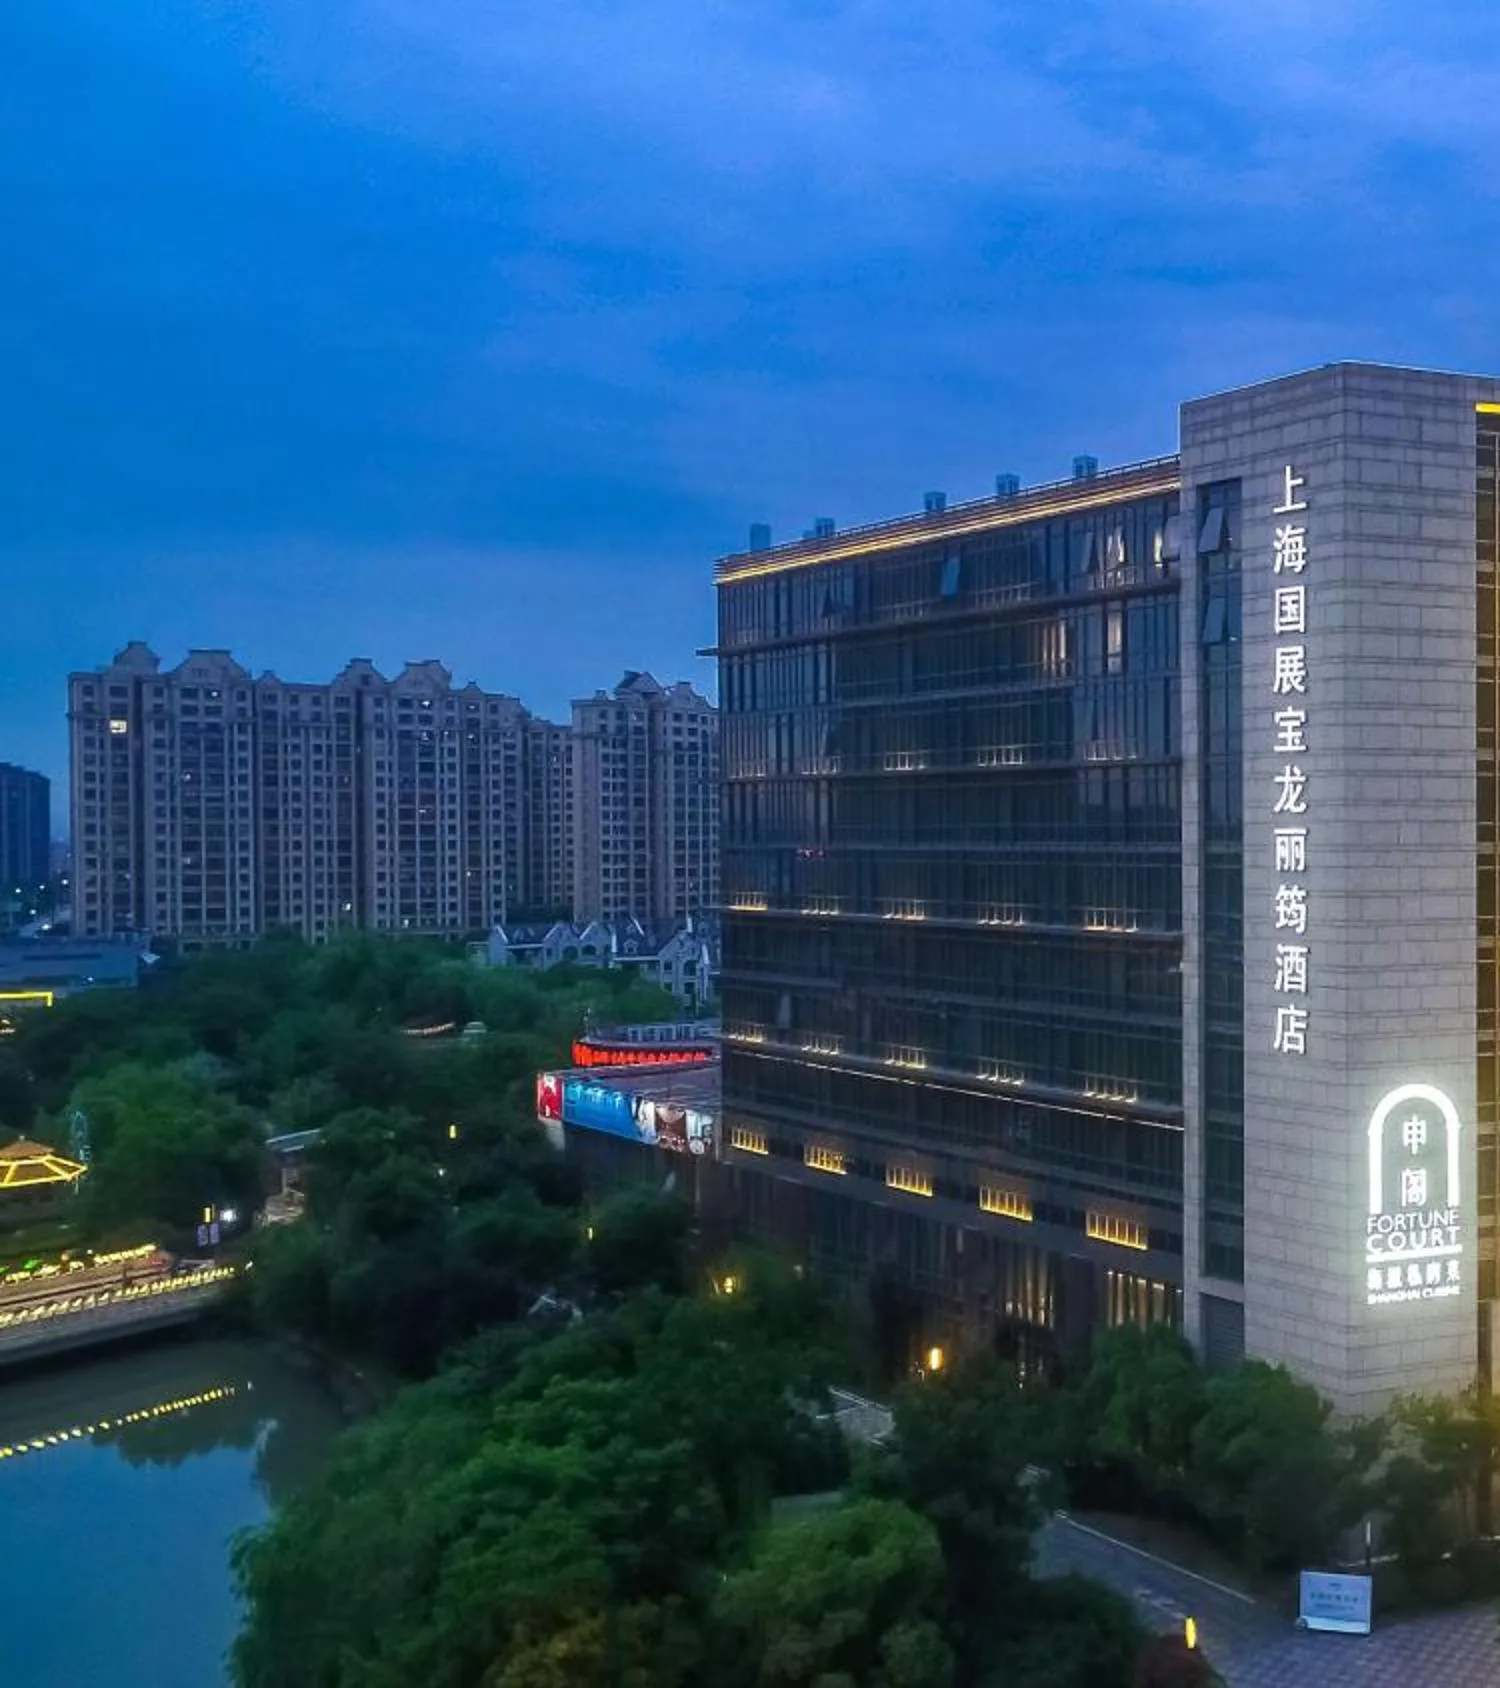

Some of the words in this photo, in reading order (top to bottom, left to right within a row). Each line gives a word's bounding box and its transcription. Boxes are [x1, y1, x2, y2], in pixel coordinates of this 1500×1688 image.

[1272, 465, 1308, 1054] 上海国展宝龙丽筠酒店
[1367, 1209, 1460, 1234] FORTUNE
[1366, 1226, 1461, 1254] COURT
